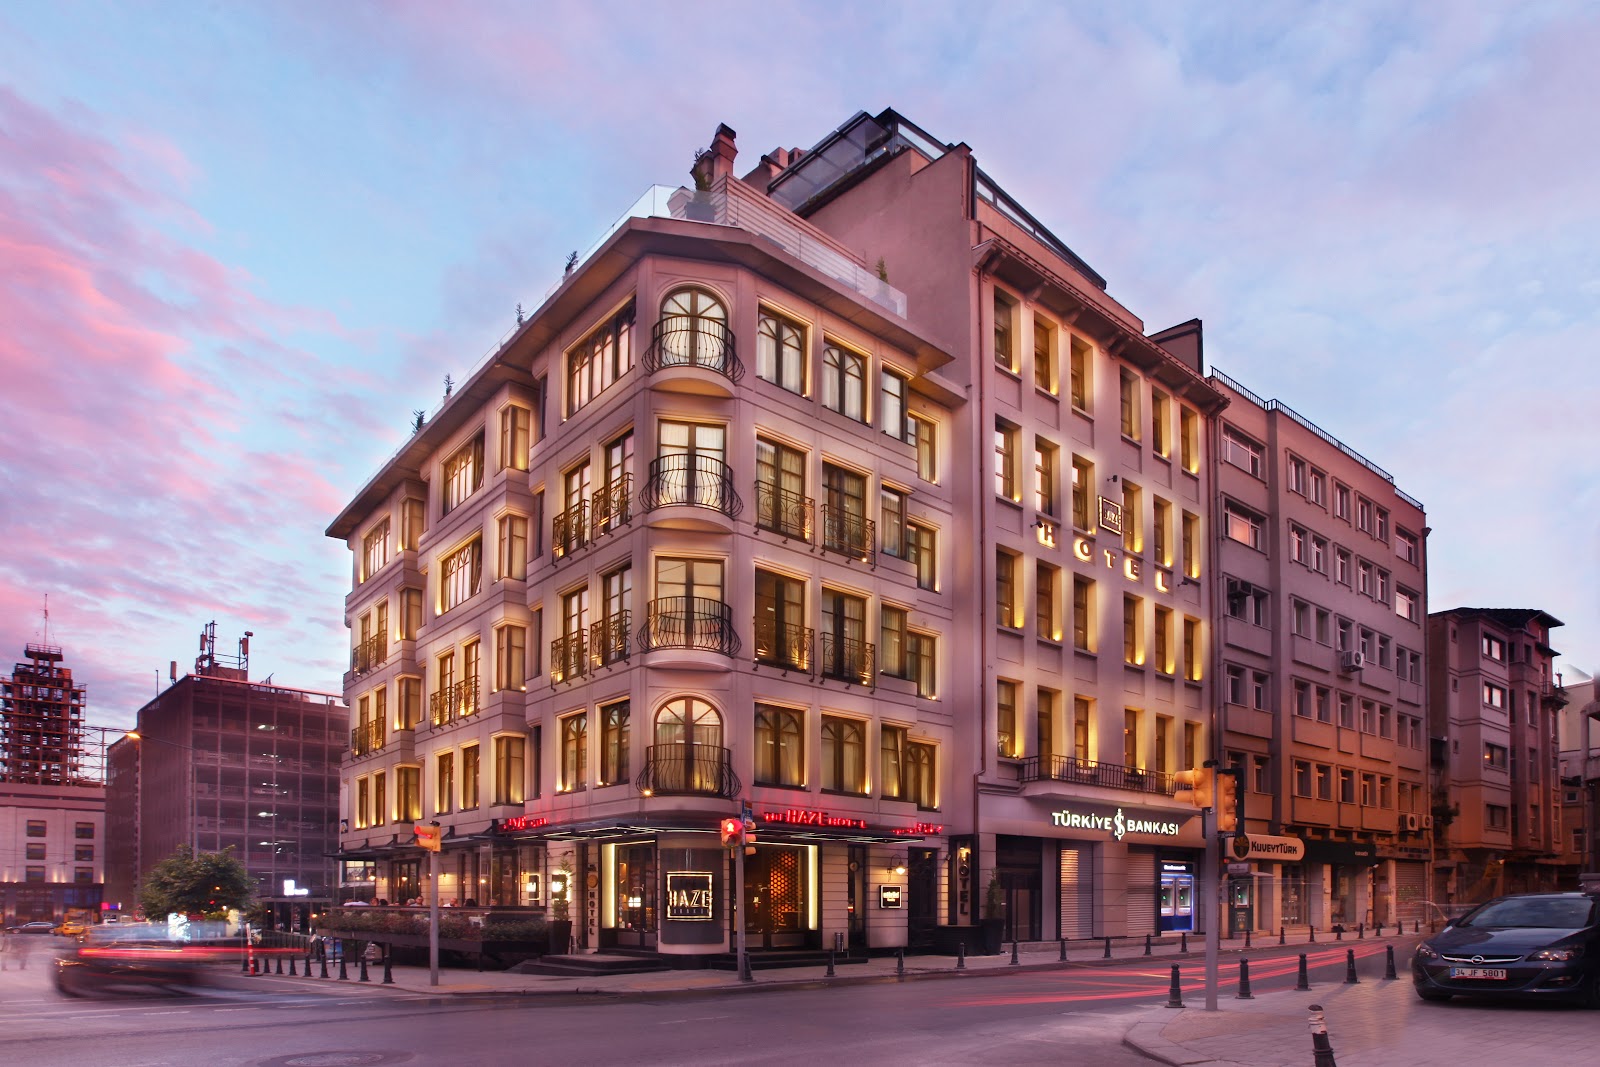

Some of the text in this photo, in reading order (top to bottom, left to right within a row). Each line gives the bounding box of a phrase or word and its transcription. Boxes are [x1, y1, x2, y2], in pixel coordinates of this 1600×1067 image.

[1041, 523, 1169, 592] HOTEL
[786, 808, 828, 826] HAZE
[1051, 809, 1112, 830] TÜRKİYE
[1127, 819, 1180, 836] BANKASI
[1455, 968, 1465, 976] 34
[1482, 969, 1505, 978] 5801
